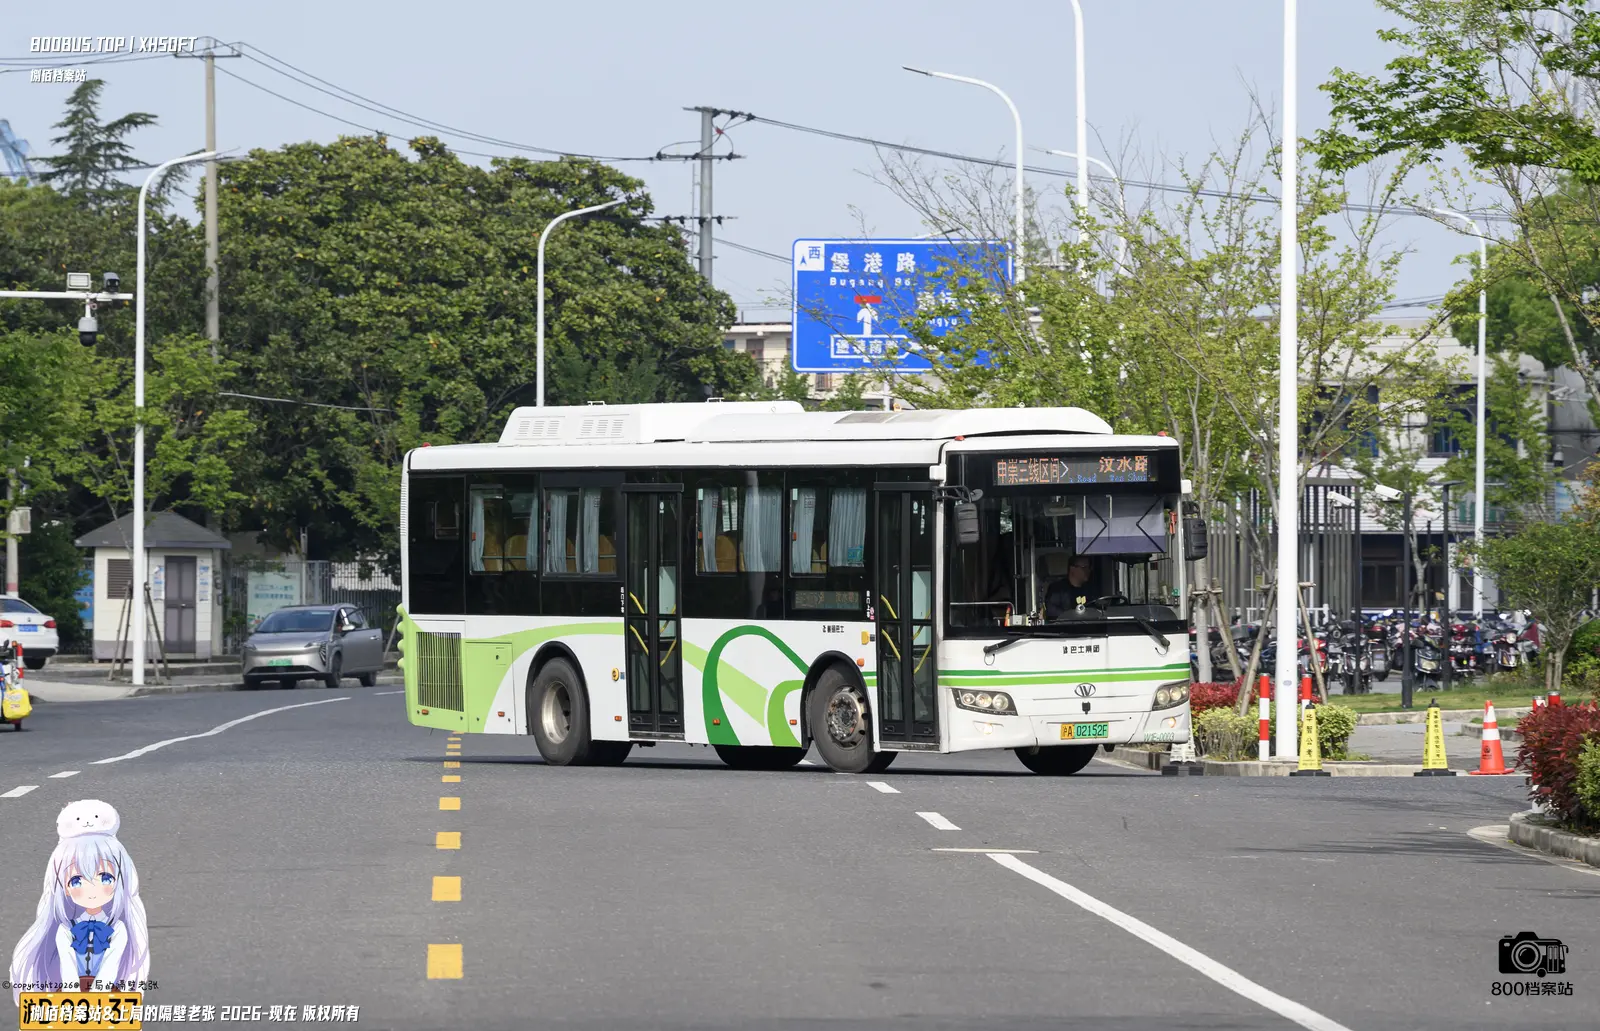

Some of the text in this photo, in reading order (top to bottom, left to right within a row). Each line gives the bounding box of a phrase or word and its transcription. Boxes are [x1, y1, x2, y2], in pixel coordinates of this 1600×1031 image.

[808, 246, 821, 259] 西
[831, 252, 916, 273] 堡港路
